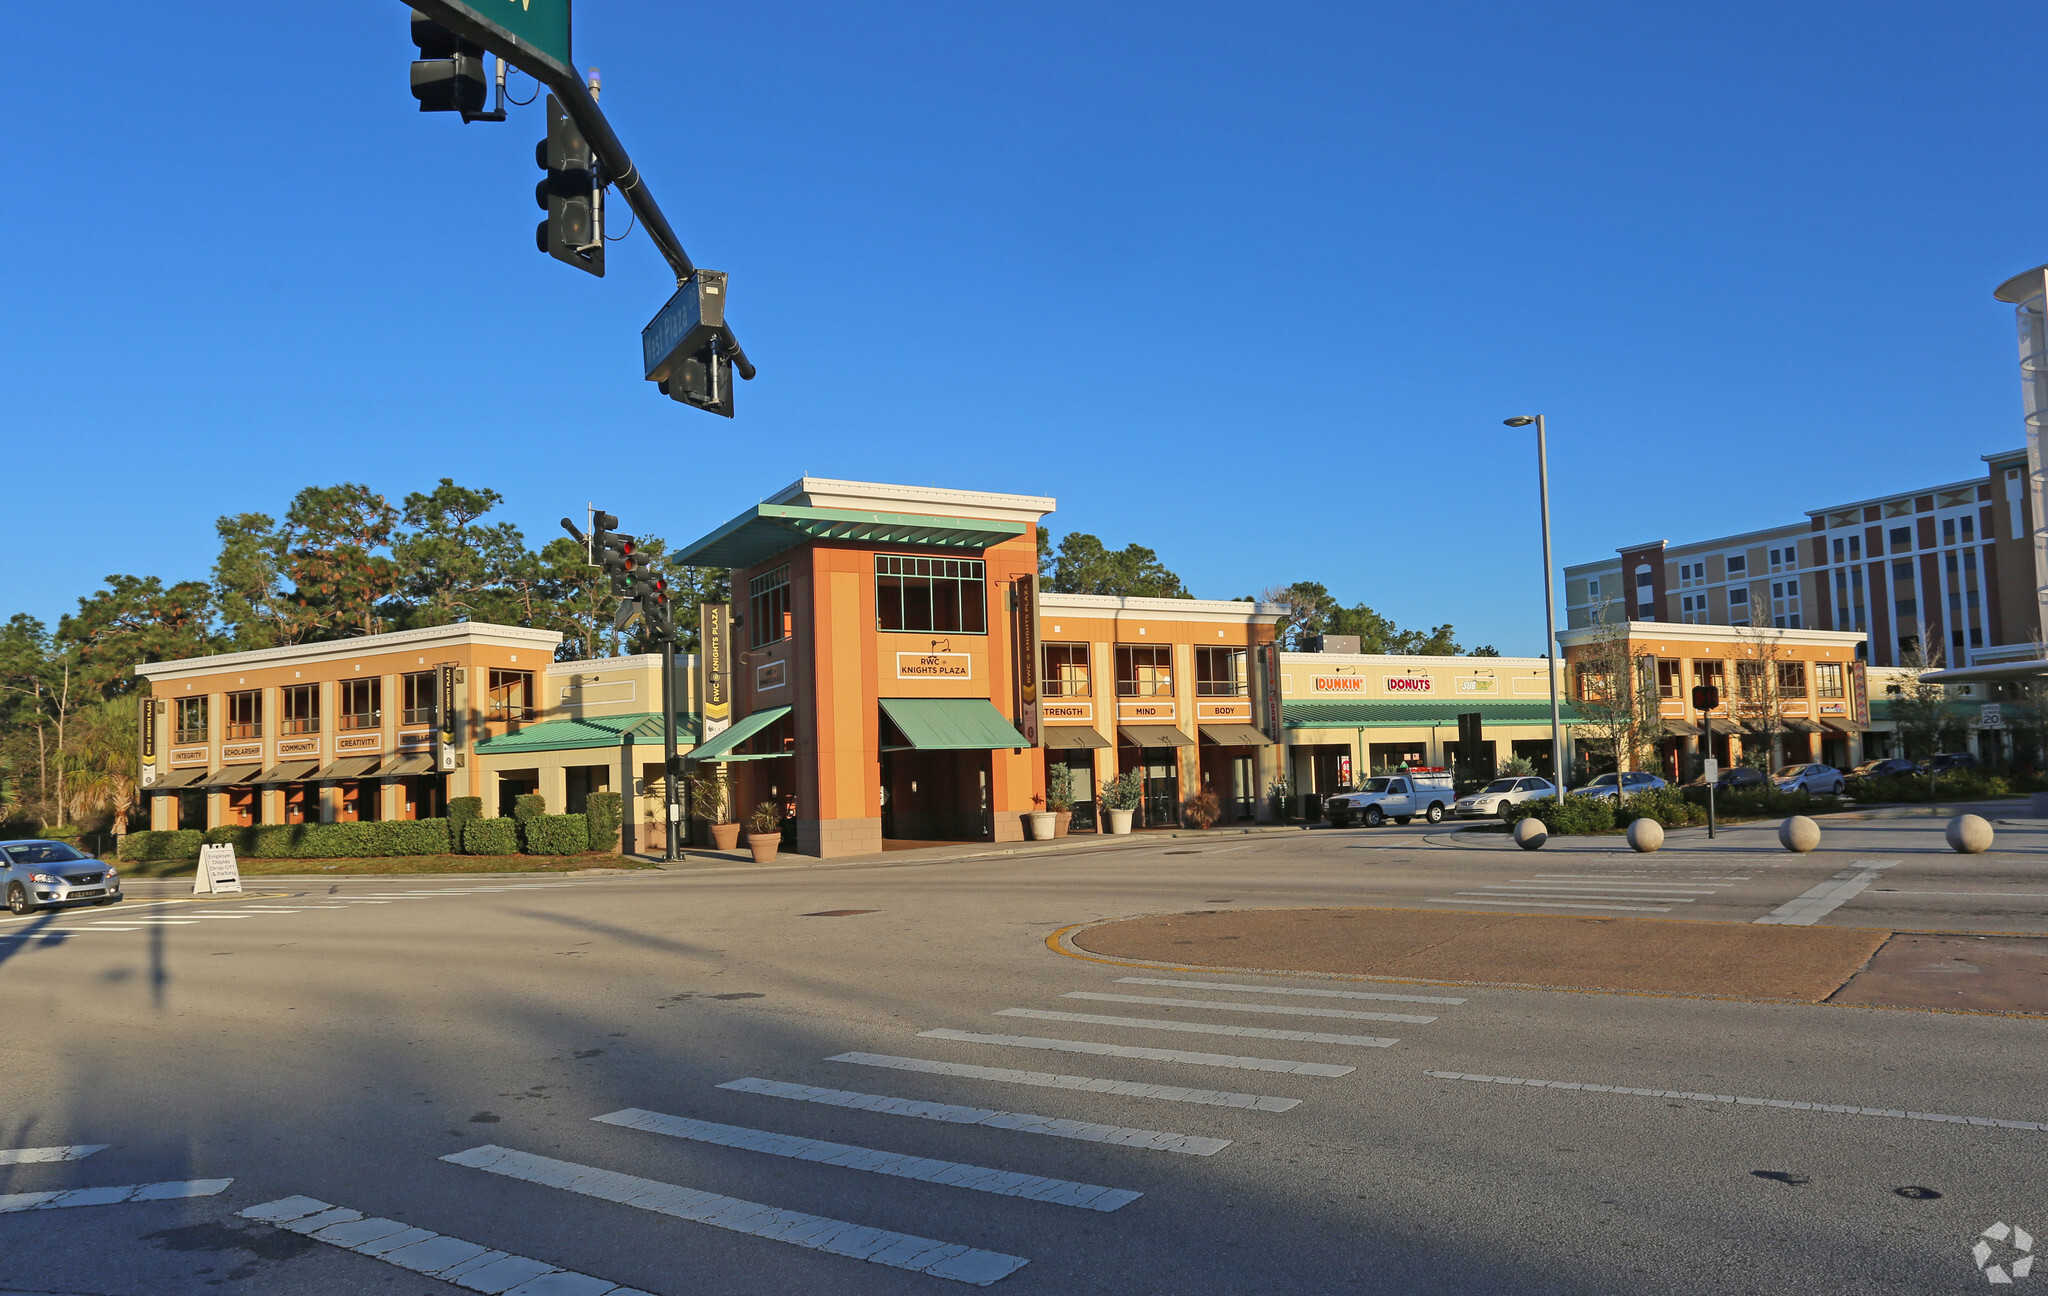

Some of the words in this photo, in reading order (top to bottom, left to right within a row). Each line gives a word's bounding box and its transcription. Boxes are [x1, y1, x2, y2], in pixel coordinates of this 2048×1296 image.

[646, 329, 664, 366] West
[664, 305, 688, 346] Plaza
[711, 608, 719, 635] PLAZA
[921, 658, 939, 666] RWC
[901, 666, 937, 674] KNIGHTS
[1316, 678, 1363, 690] DUNKIN'
[1388, 679, 1430, 691] DONUTS
[1983, 715, 1999, 724] 20
[281, 743, 315, 752] COMMUNITY
[340, 738, 375, 748] CREATIVITY
[176, 752, 202, 760] INTEGRITY
[224, 747, 260, 757] SCHOLARSHIP
